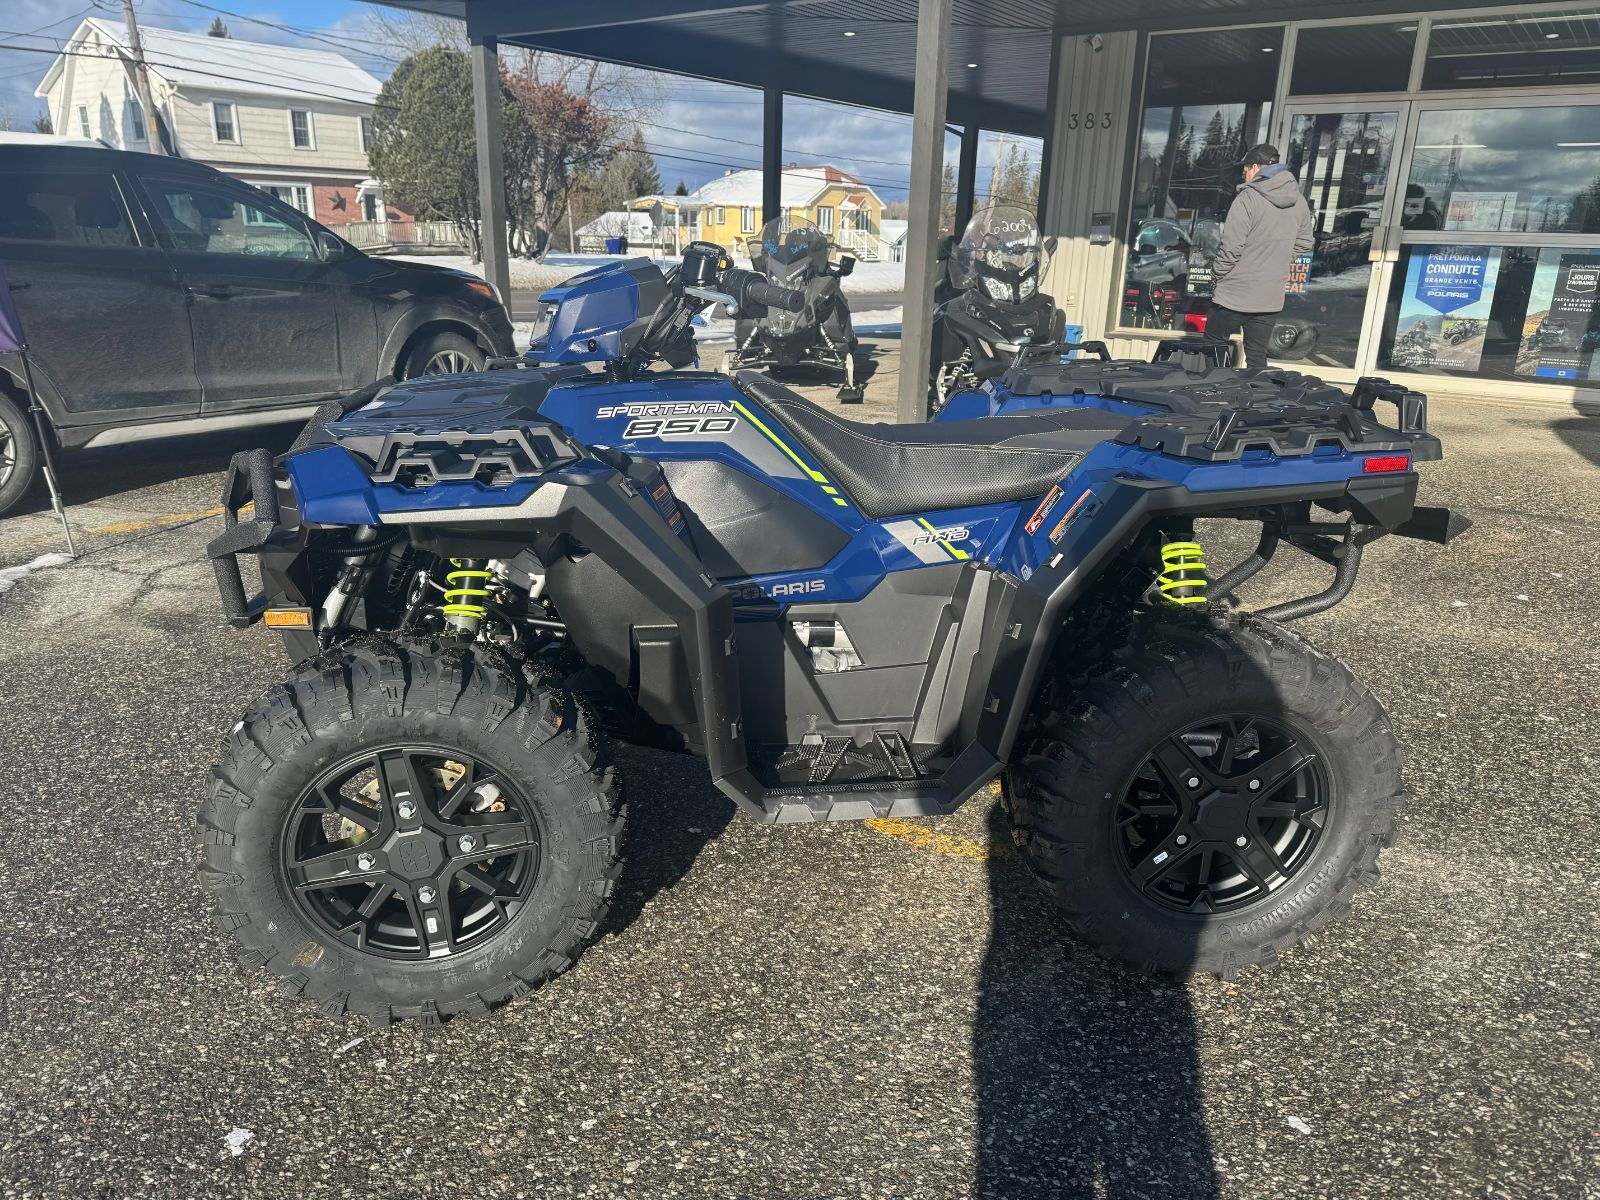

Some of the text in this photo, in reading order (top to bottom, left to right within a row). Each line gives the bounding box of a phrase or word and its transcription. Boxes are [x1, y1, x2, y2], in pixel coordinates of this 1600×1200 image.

[1068, 112, 1112, 130] 383
[1449, 254, 1470, 262] POUR
[1471, 254, 1482, 262] LA
[1290, 263, 1310, 273] TCH
[1426, 264, 1480, 275] CONDUITE
[1285, 282, 1306, 293] EAL
[596, 402, 735, 418] SPORTSMAN
[622, 416, 739, 440] 850
[912, 529, 970, 547] AWD
[729, 579, 826, 600] POLARIS
